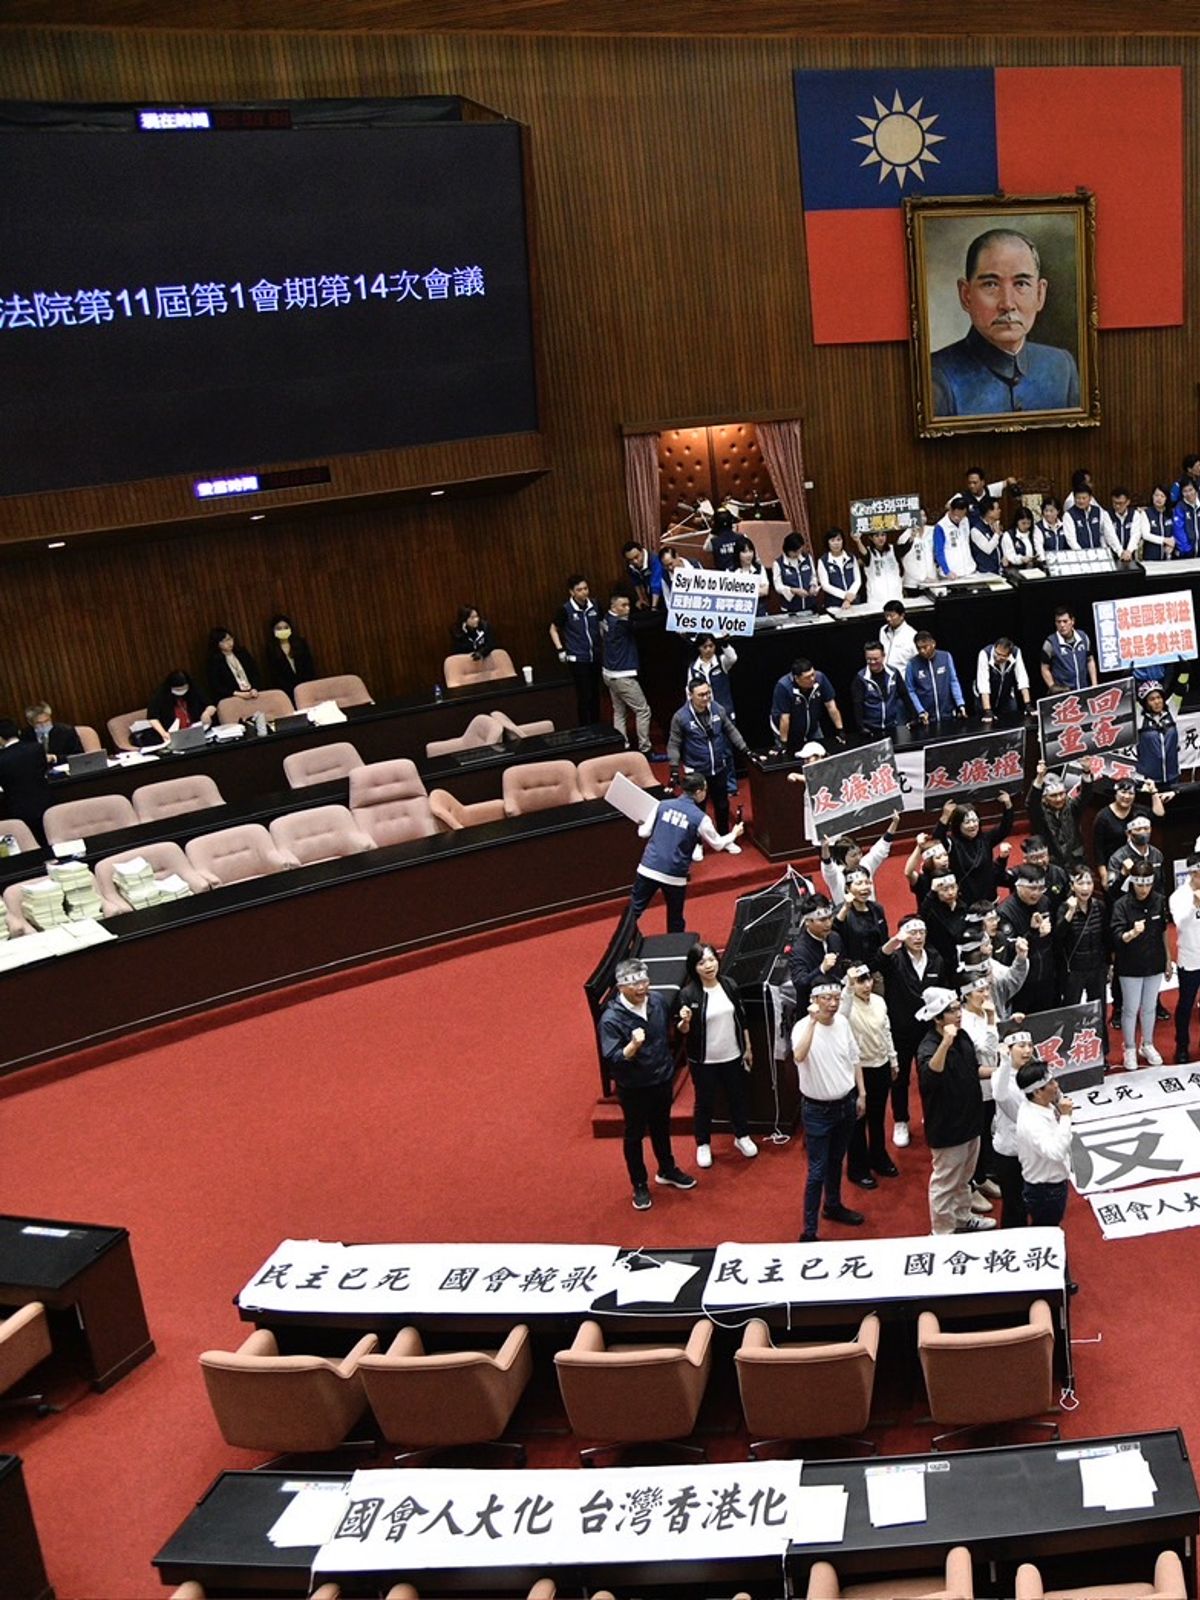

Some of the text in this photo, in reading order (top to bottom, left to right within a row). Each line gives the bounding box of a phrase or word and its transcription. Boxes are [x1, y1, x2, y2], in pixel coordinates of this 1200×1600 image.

[675, 574, 756, 593] Say No to Violence
[675, 613, 747, 632] Yes to Vote
[1117, 600, 1191, 630] 就是國家利益
[254, 1262, 598, 1294] 民主已死 國會輓歌
[714, 1245, 1061, 1285] 民主已死 國會輓歌
[334, 1480, 789, 1544] 國會人大化 台灣香港化
